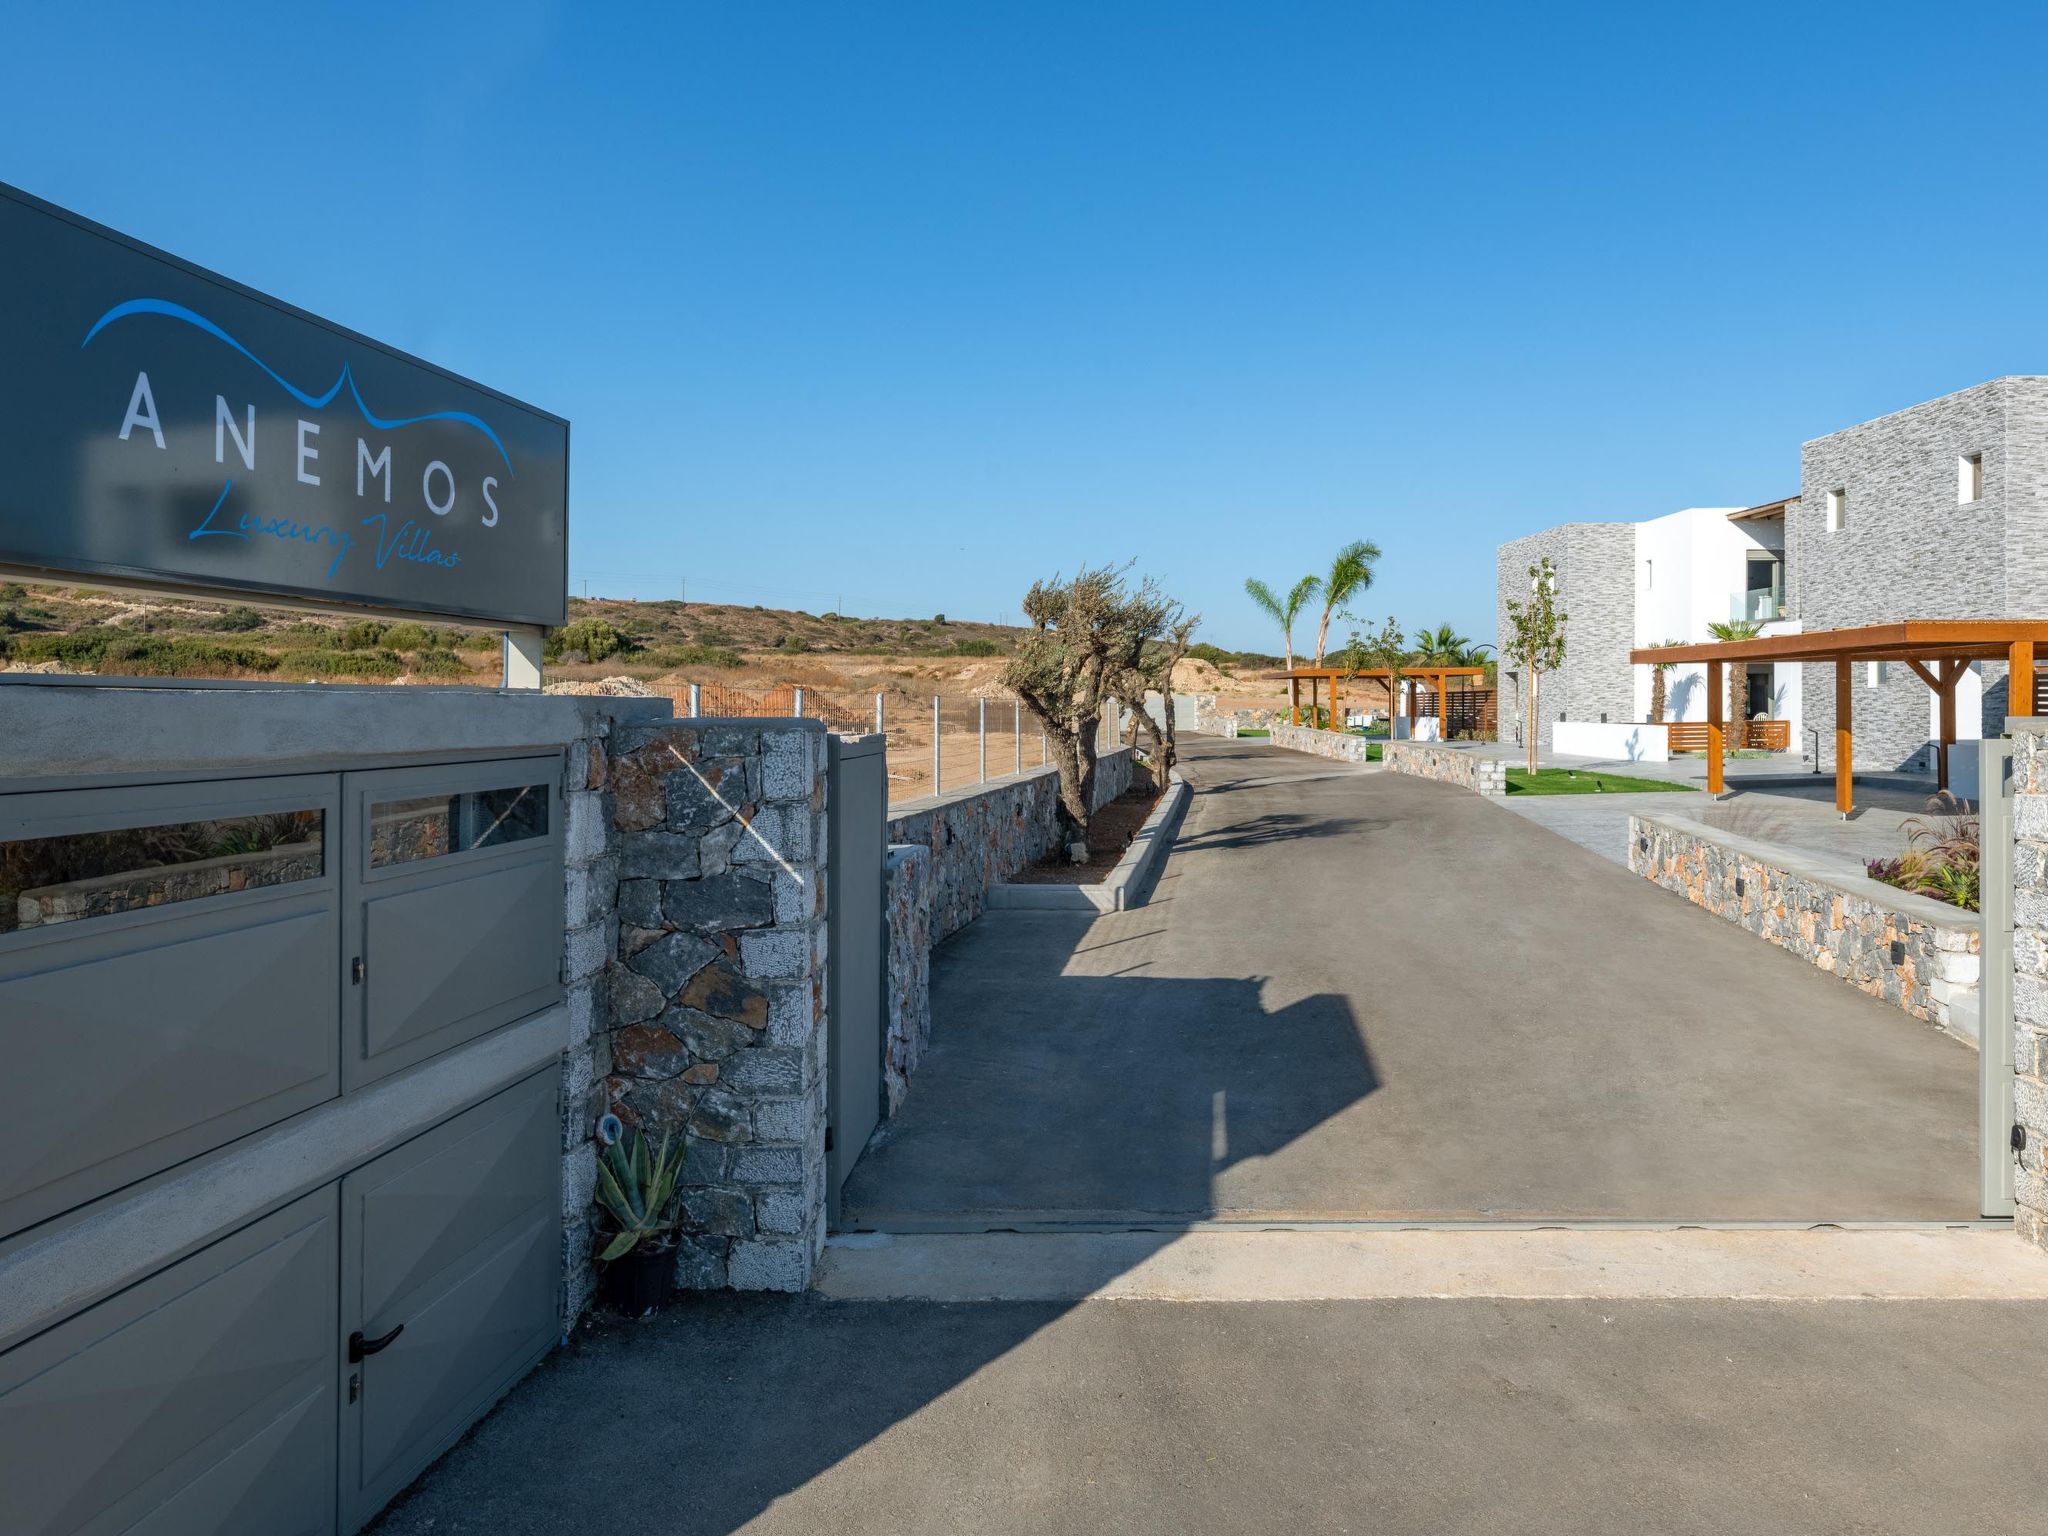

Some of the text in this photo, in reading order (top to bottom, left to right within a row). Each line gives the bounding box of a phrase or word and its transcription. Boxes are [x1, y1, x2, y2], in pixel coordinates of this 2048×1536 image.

[118, 371, 499, 528] ANEMOS
[188, 479, 462, 578] Luxury Villas
